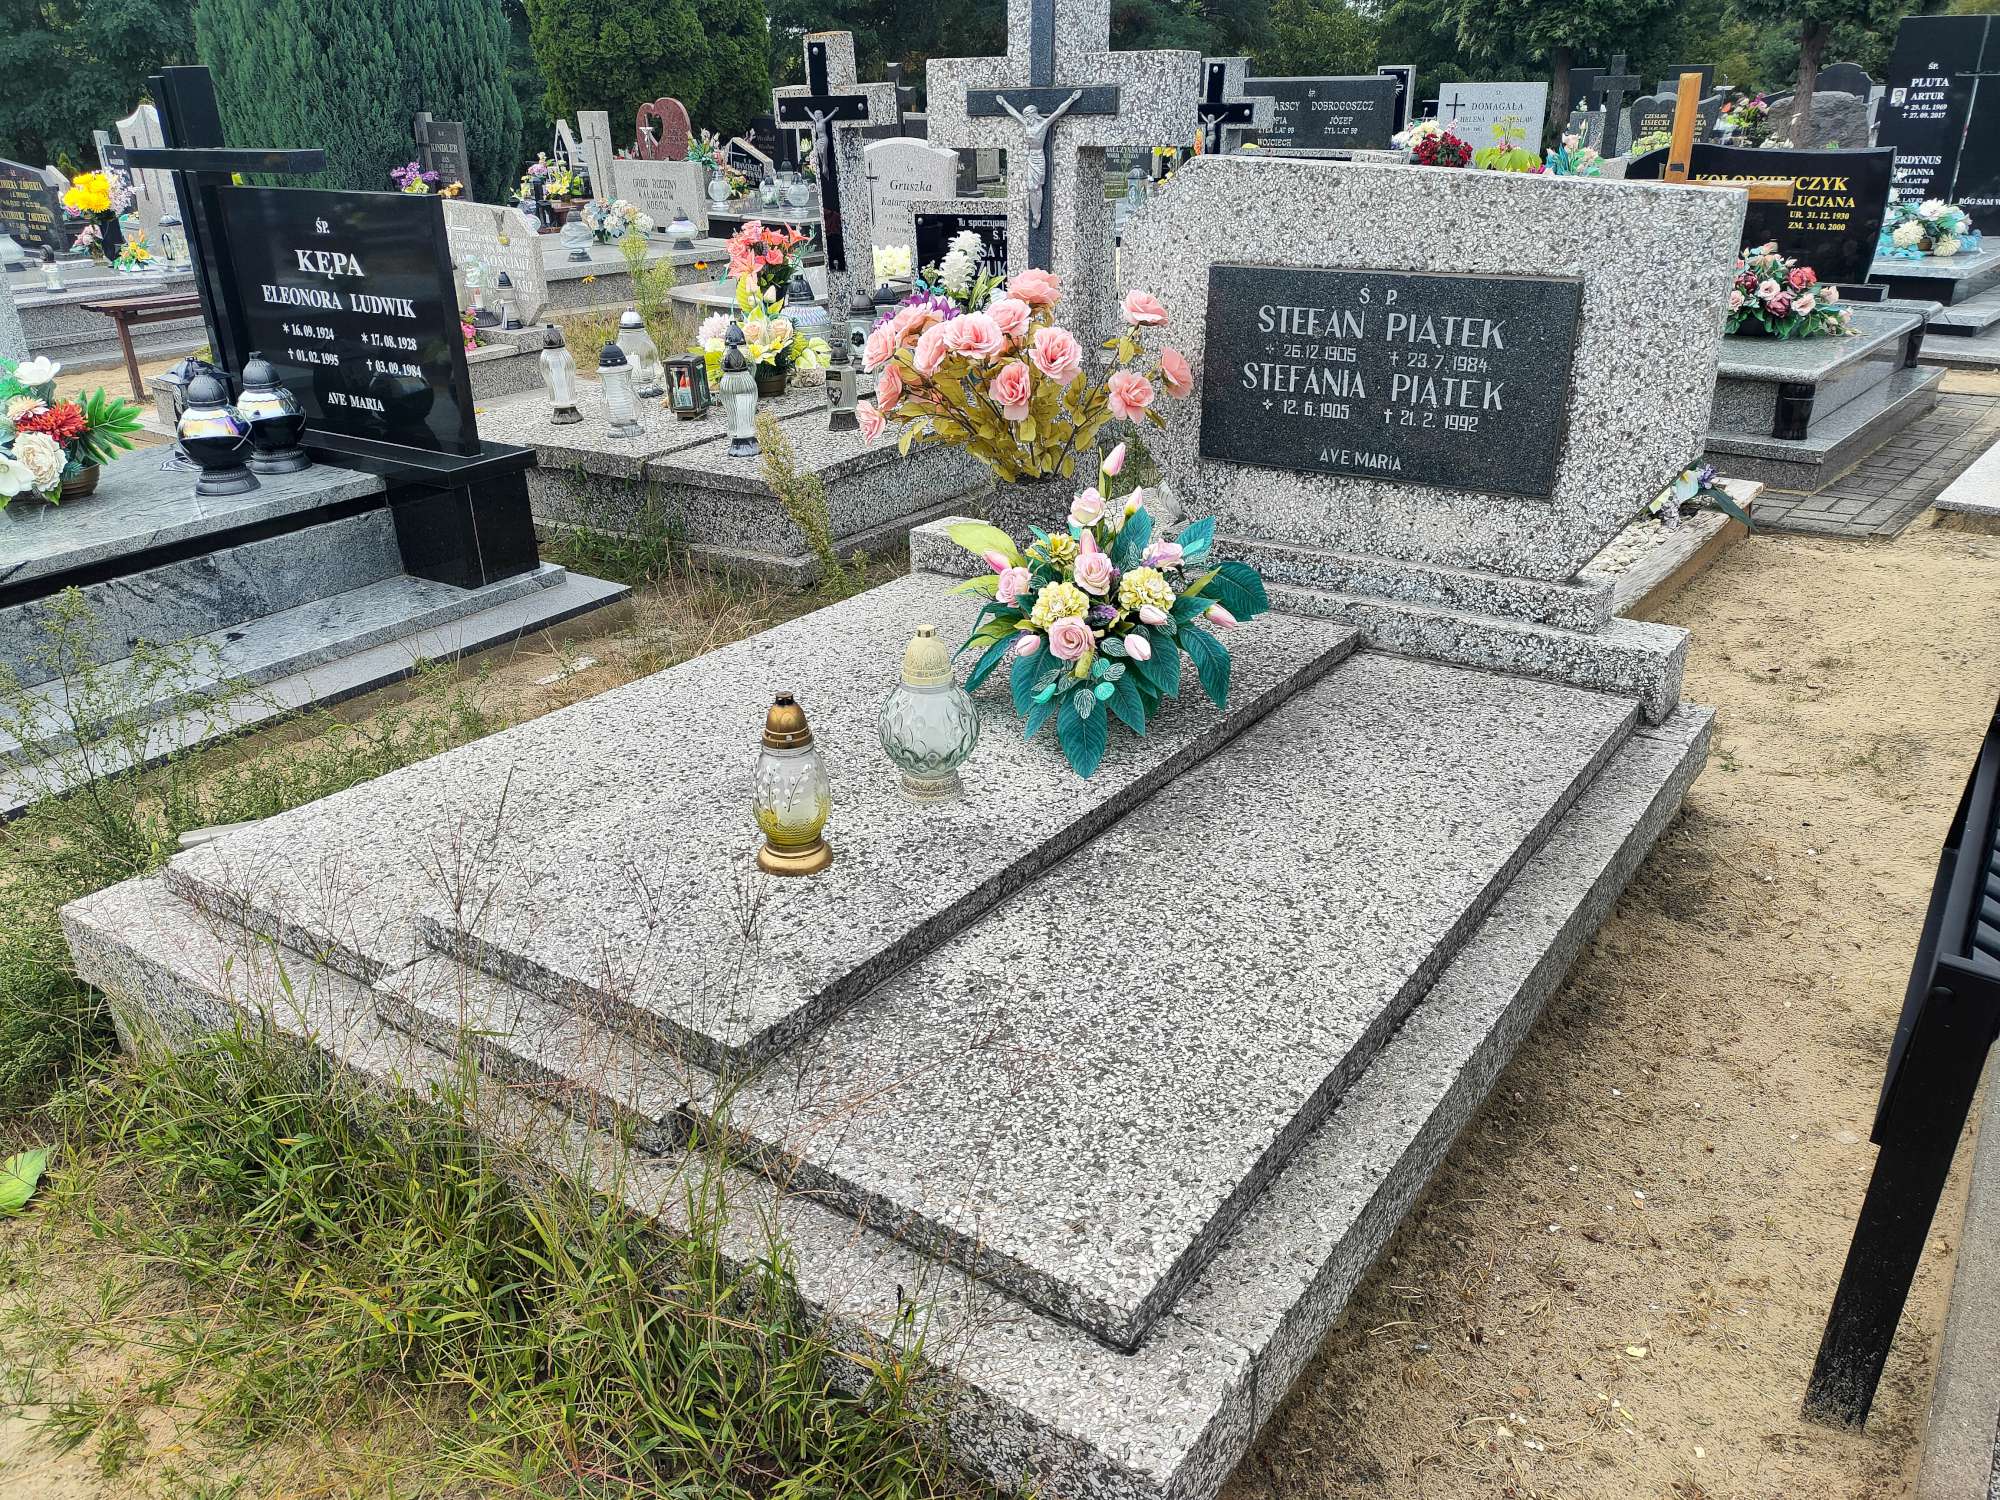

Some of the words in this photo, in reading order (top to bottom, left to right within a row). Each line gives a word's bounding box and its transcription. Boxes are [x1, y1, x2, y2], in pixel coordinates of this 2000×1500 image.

[1910, 78, 1950, 88] PLUTA
[1910, 92, 1945, 100] ARTUR
[1274, 101, 1300, 111] ARSCY
[1311, 100, 1375, 111] DOBROGOSZCZ
[430, 144, 458, 153] KINDLER
[1894, 155, 1942, 164] ERDYNUS
[890, 180, 932, 192] Gruszka
[294, 249, 366, 280] KĘPA
[261, 284, 344, 310] ELEONORA
[350, 293, 416, 318] LUDWIK
[1258, 304, 1365, 339] STEFAN
[1242, 362, 1366, 398] STEFANIA
[328, 392, 348, 406] AVE
[349, 395, 384, 412] MARIA
[1320, 448, 1350, 464] AVE
